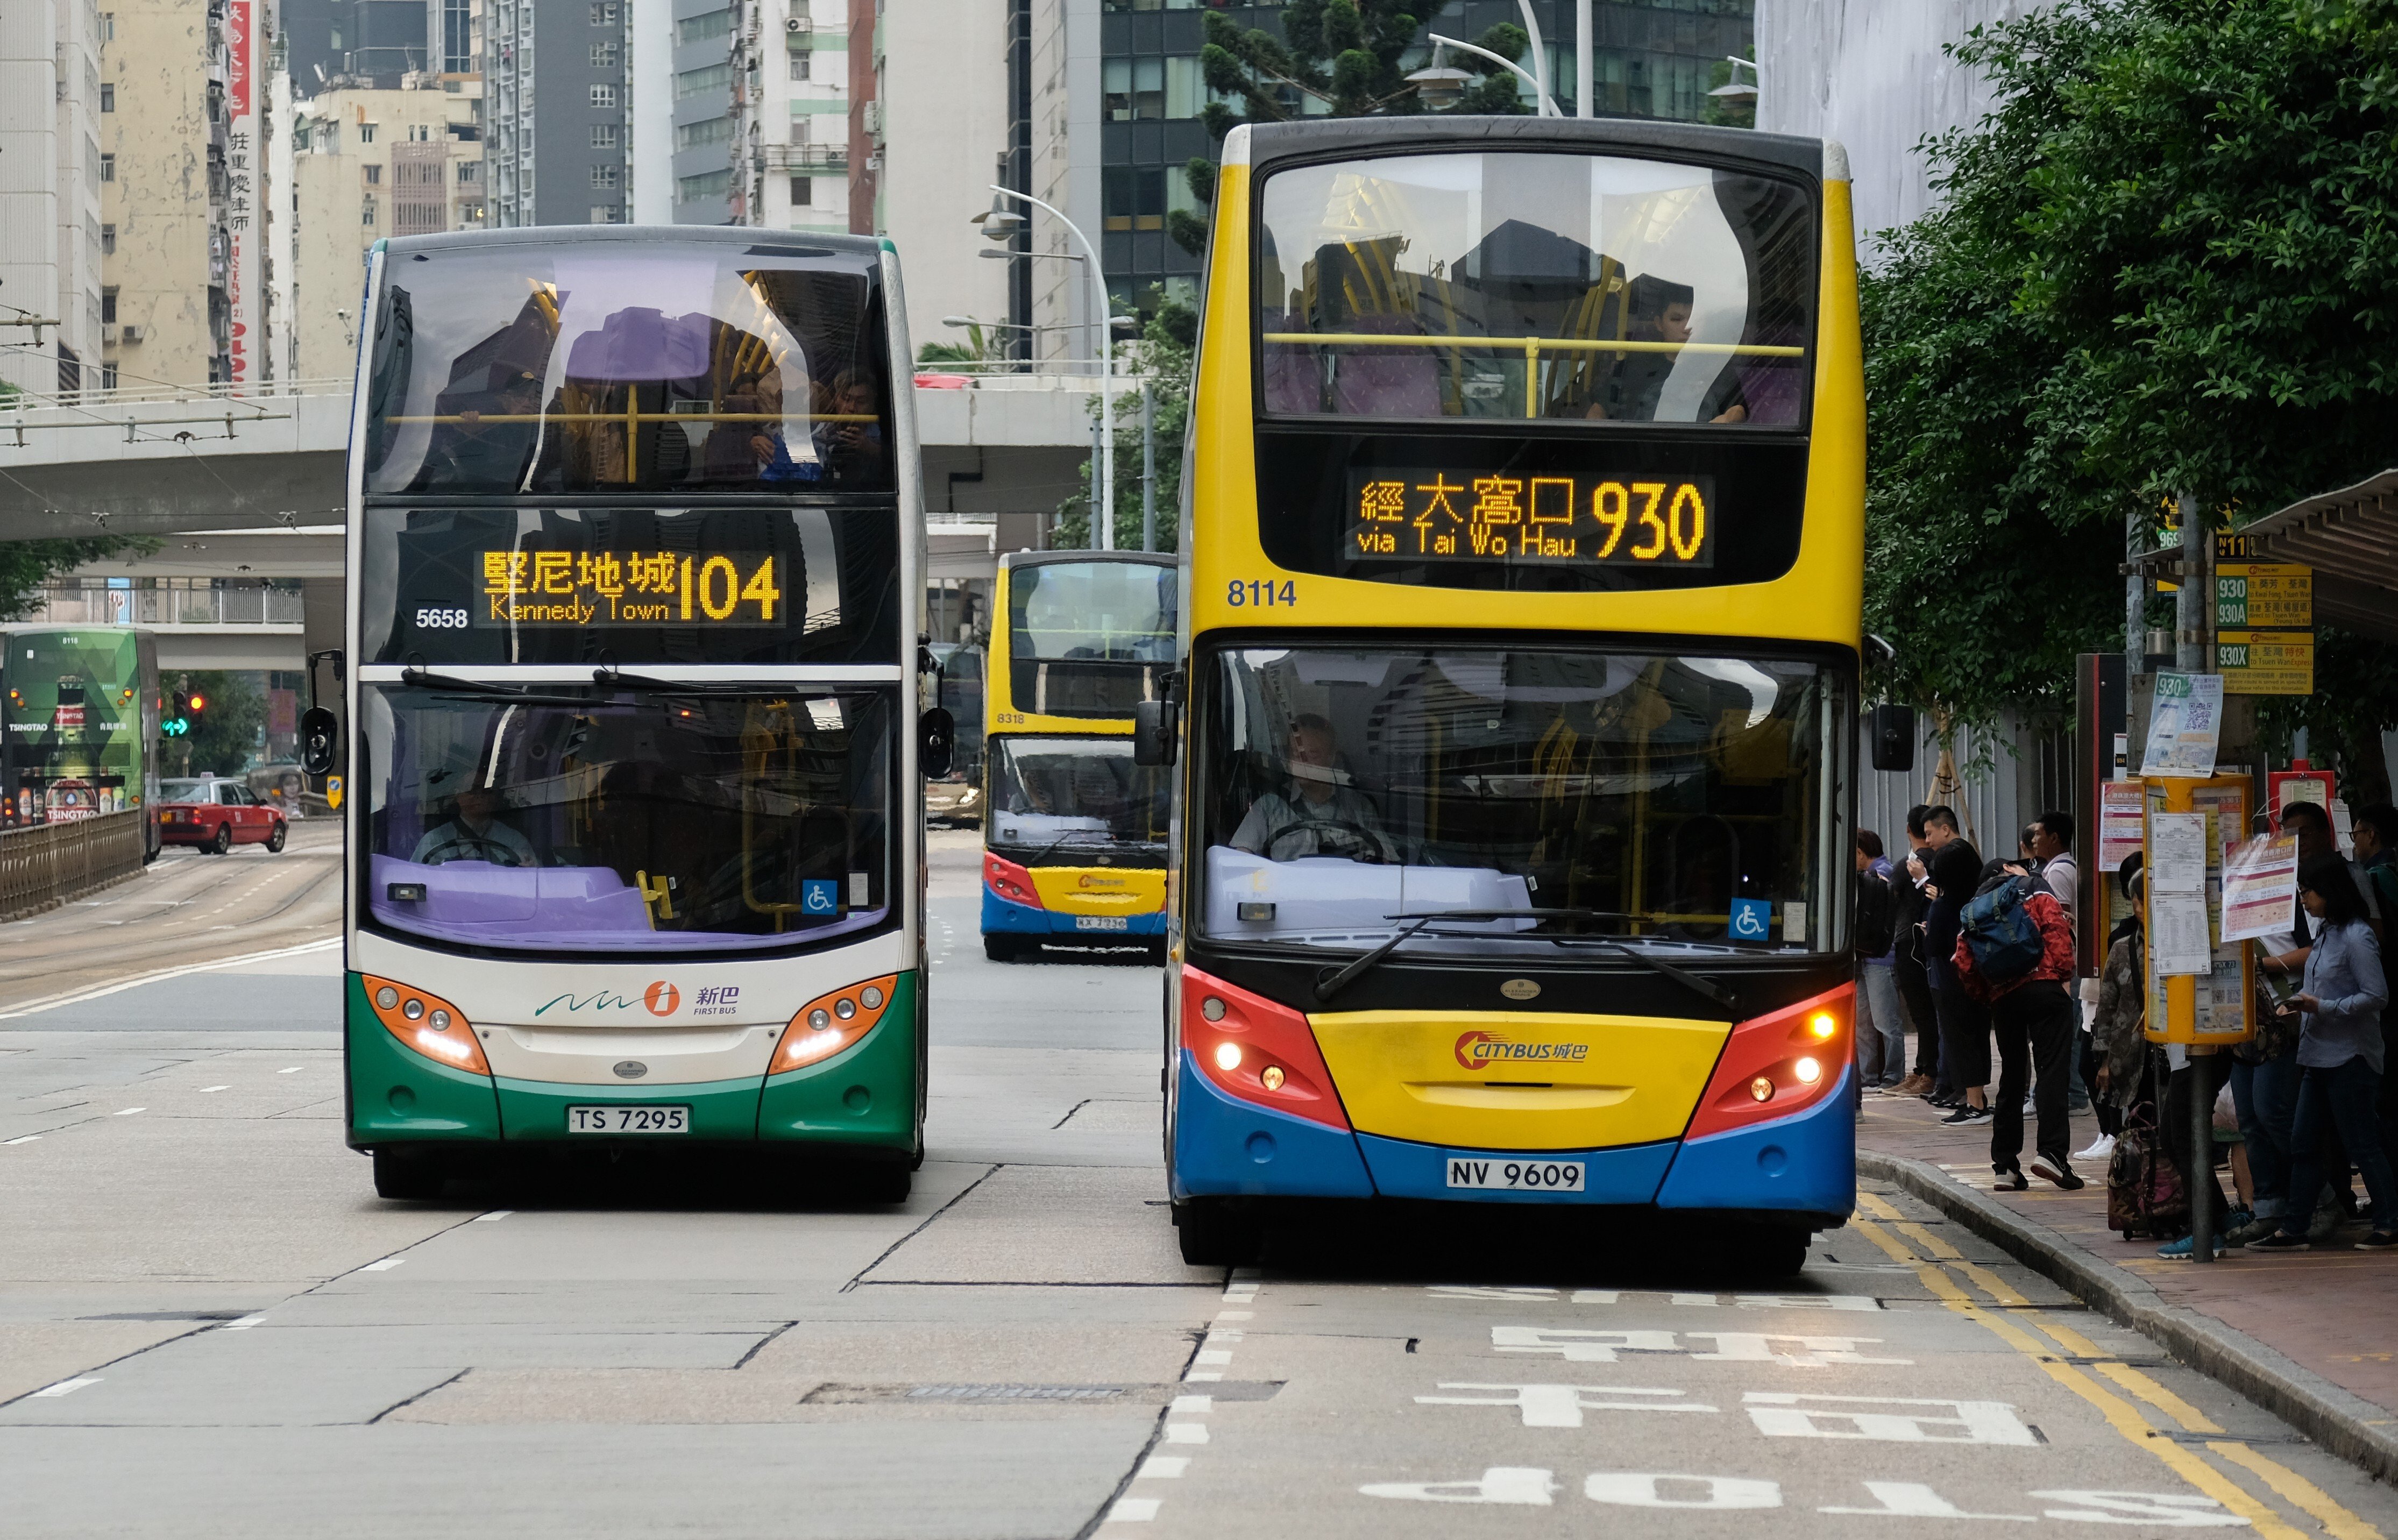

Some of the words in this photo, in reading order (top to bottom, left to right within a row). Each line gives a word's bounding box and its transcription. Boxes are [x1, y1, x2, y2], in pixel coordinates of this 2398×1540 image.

[1591, 481, 1706, 561] 930
[1358, 526, 1395, 552] via
[1412, 521, 1456, 555] Tai
[1469, 523, 1507, 556] Wo
[1521, 524, 1576, 557] Hau
[484, 551, 676, 595] 堅尼地城
[679, 555, 781, 621] 104
[1227, 580, 1297, 607] 8114
[2219, 579, 2246, 598] 930
[415, 608, 469, 629] 5658
[490, 594, 594, 624] Kennedy
[602, 594, 670, 621] Town
[2219, 603, 2246, 623] 930A
[2220, 646, 2246, 665] 930X
[2259, 657, 2276, 665] Tsuen
[2159, 677, 2182, 697] 930
[9, 723, 48, 732] TSINGTAO
[997, 713, 1025, 725] 8318
[696, 986, 740, 1006] 新巴
[694, 1007, 717, 1016] FIRST
[719, 1006, 737, 1015] BUS
[1473, 1042, 1552, 1060] CITYBUS
[1552, 1042, 1589, 1060] 城巴
[576, 1110, 606, 1130] TS
[618, 1110, 683, 1130] 7295
[1453, 1161, 1489, 1185] NV
[1504, 1163, 1579, 1188] 9609
[1358, 1467, 2252, 1527] STOP
